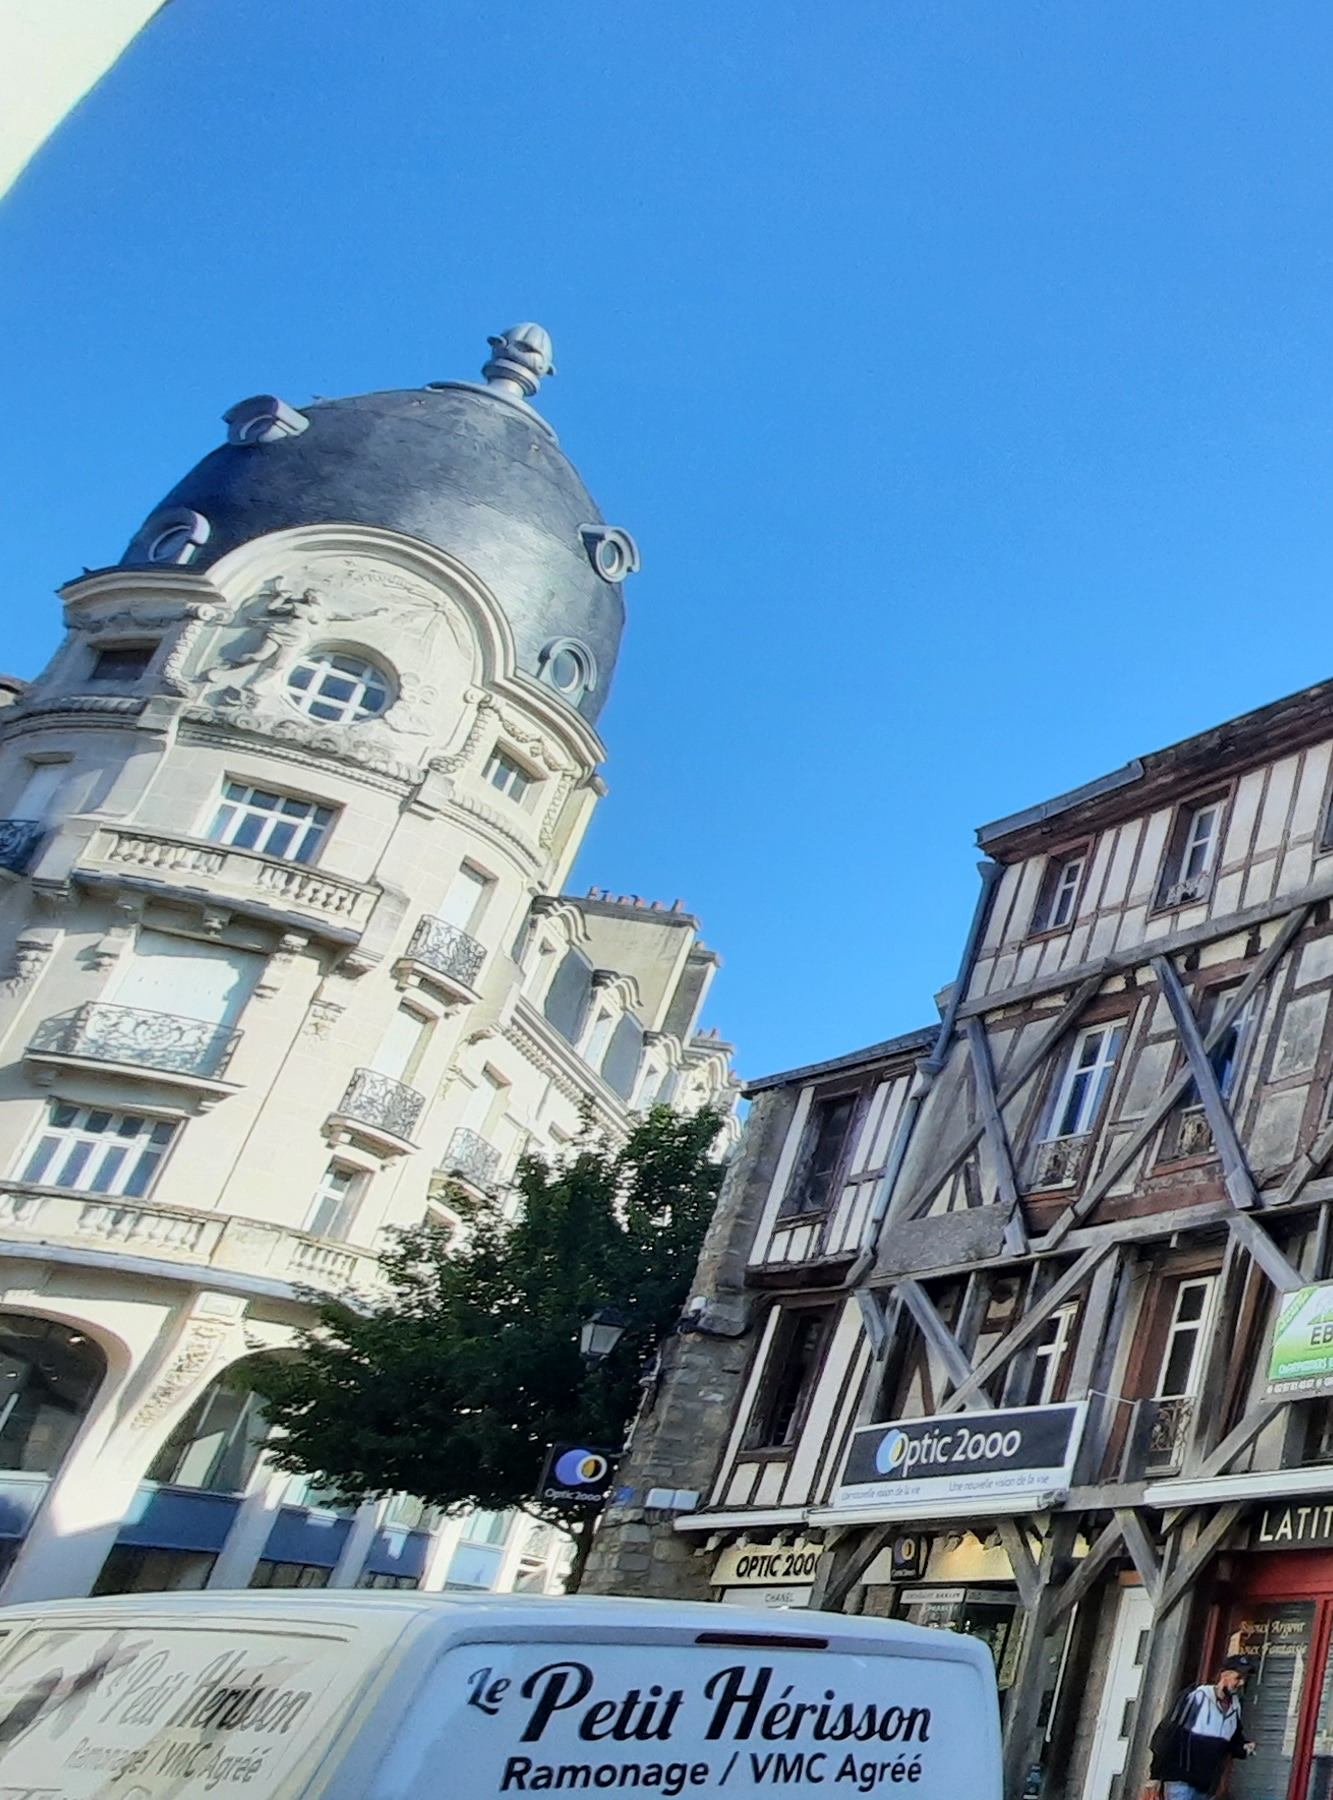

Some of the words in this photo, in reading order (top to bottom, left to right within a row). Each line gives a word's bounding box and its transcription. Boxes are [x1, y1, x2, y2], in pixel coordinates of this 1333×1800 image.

[888, 1428, 952, 1478] Optic
[952, 1428, 1021, 1463] 2000
[736, 1553, 782, 1577] OPTIC
[98, 1649, 190, 1726] Petit
[165, 1650, 312, 1735] Hérisson
[467, 1667, 512, 1716] Le
[520, 1661, 684, 1743] Petit
[703, 1666, 931, 1743] Hérisson
[155, 1739, 213, 1778] VMC
[198, 1745, 274, 1792] Agréé
[500, 1756, 709, 1796] Ramonage
[718, 1751, 741, 1786] /
[749, 1752, 828, 1784] VMC
[834, 1753, 923, 1792] Agréé
